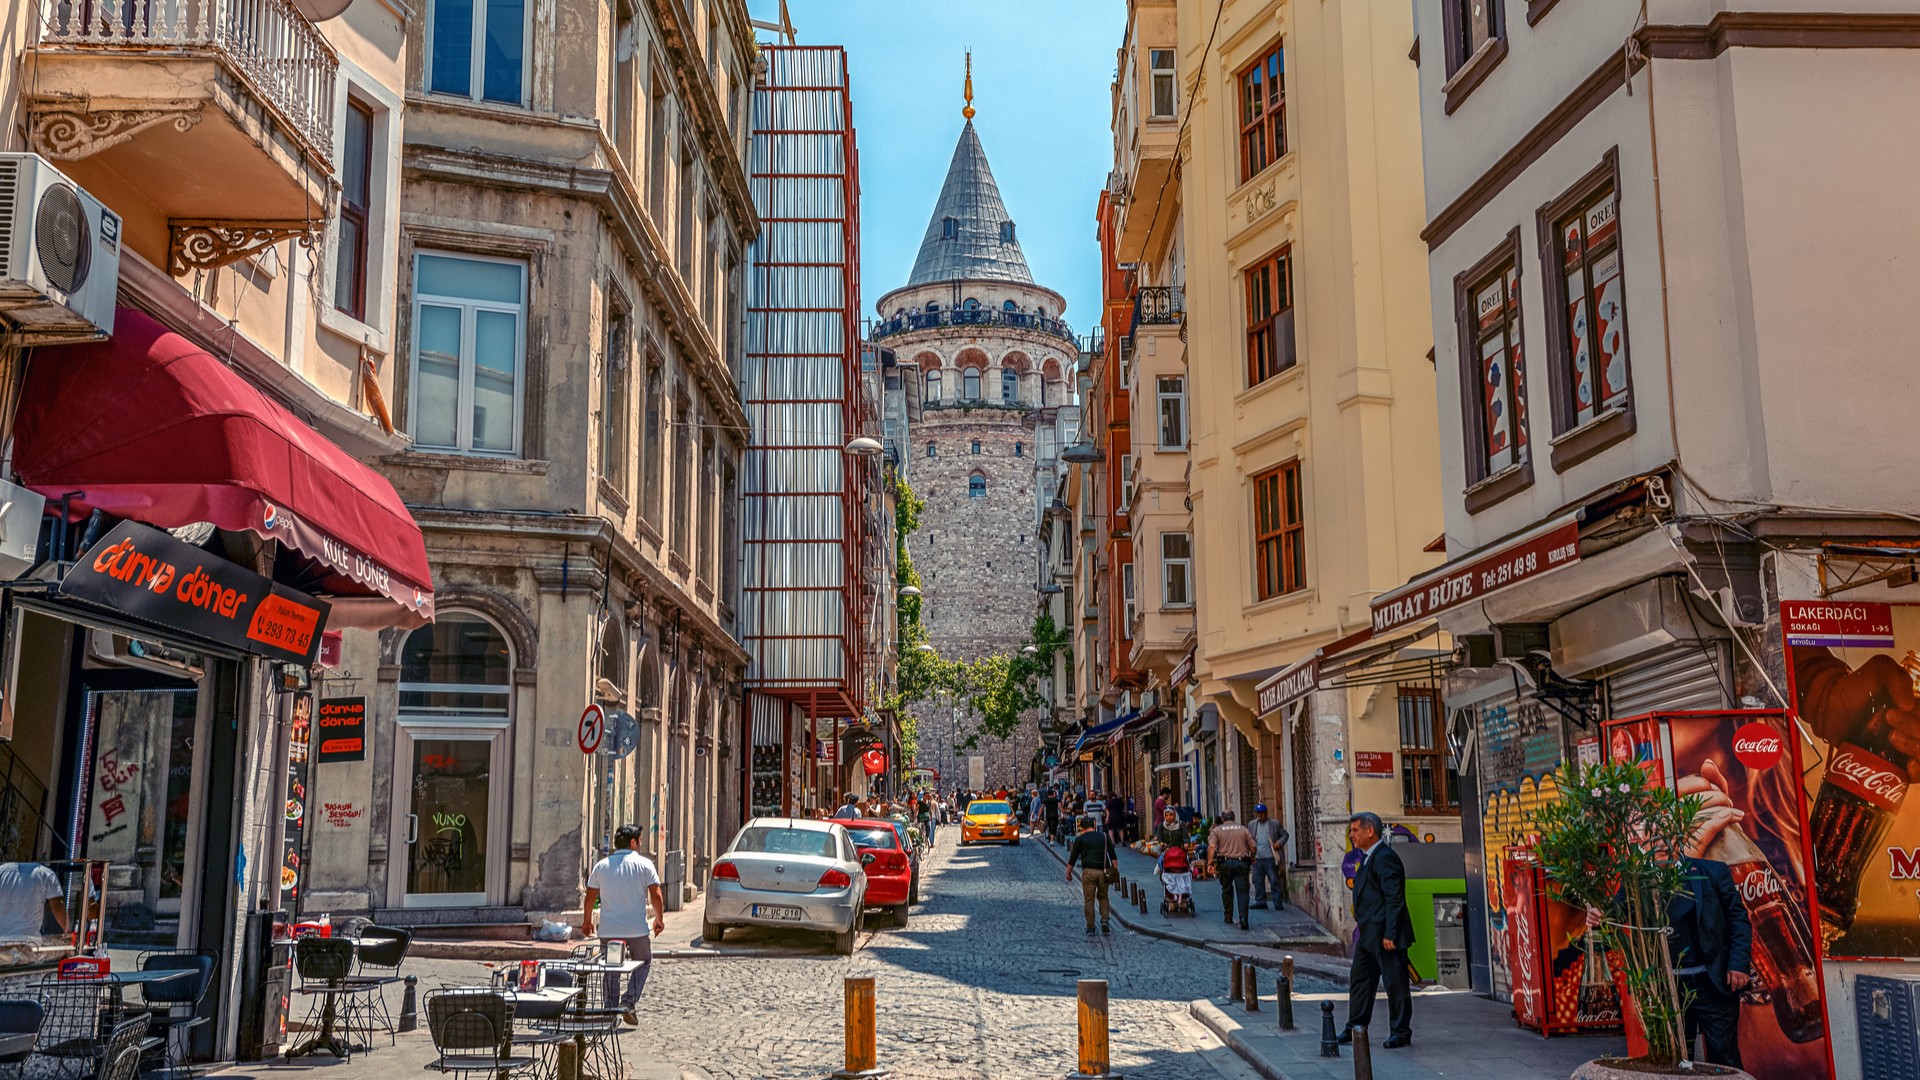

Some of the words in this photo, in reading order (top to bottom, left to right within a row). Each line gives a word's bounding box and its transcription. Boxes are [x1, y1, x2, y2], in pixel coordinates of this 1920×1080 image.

[323, 535, 350, 570] KULE
[355, 553, 390, 593] DÖNER
[93, 536, 176, 594] dünya
[176, 565, 247, 619] döner
[1373, 592, 1425, 632] MURAT
[1428, 572, 1473, 611] BÜFE
[1481, 572, 1496, 591] Tel:
[1497, 565, 1512, 585] 251
[1513, 561, 1524, 577] 49
[1526, 551, 1537, 573] 98
[1789, 606, 1867, 620] LAKERDACI
[264, 620, 283, 639] 293
[284, 627, 297, 644] 73
[297, 632, 310, 648] 45
[1790, 622, 1821, 631] SOKAĞI
[320, 703, 364, 715] dünya
[320, 716, 364, 727] döner
[1734, 737, 1781, 753] Coca-Cola
[1830, 752, 1906, 804] Coca-Cola
[432, 812, 466, 827] VUNO
[771, 908, 781, 916] UC
[785, 909, 799, 917] 016
